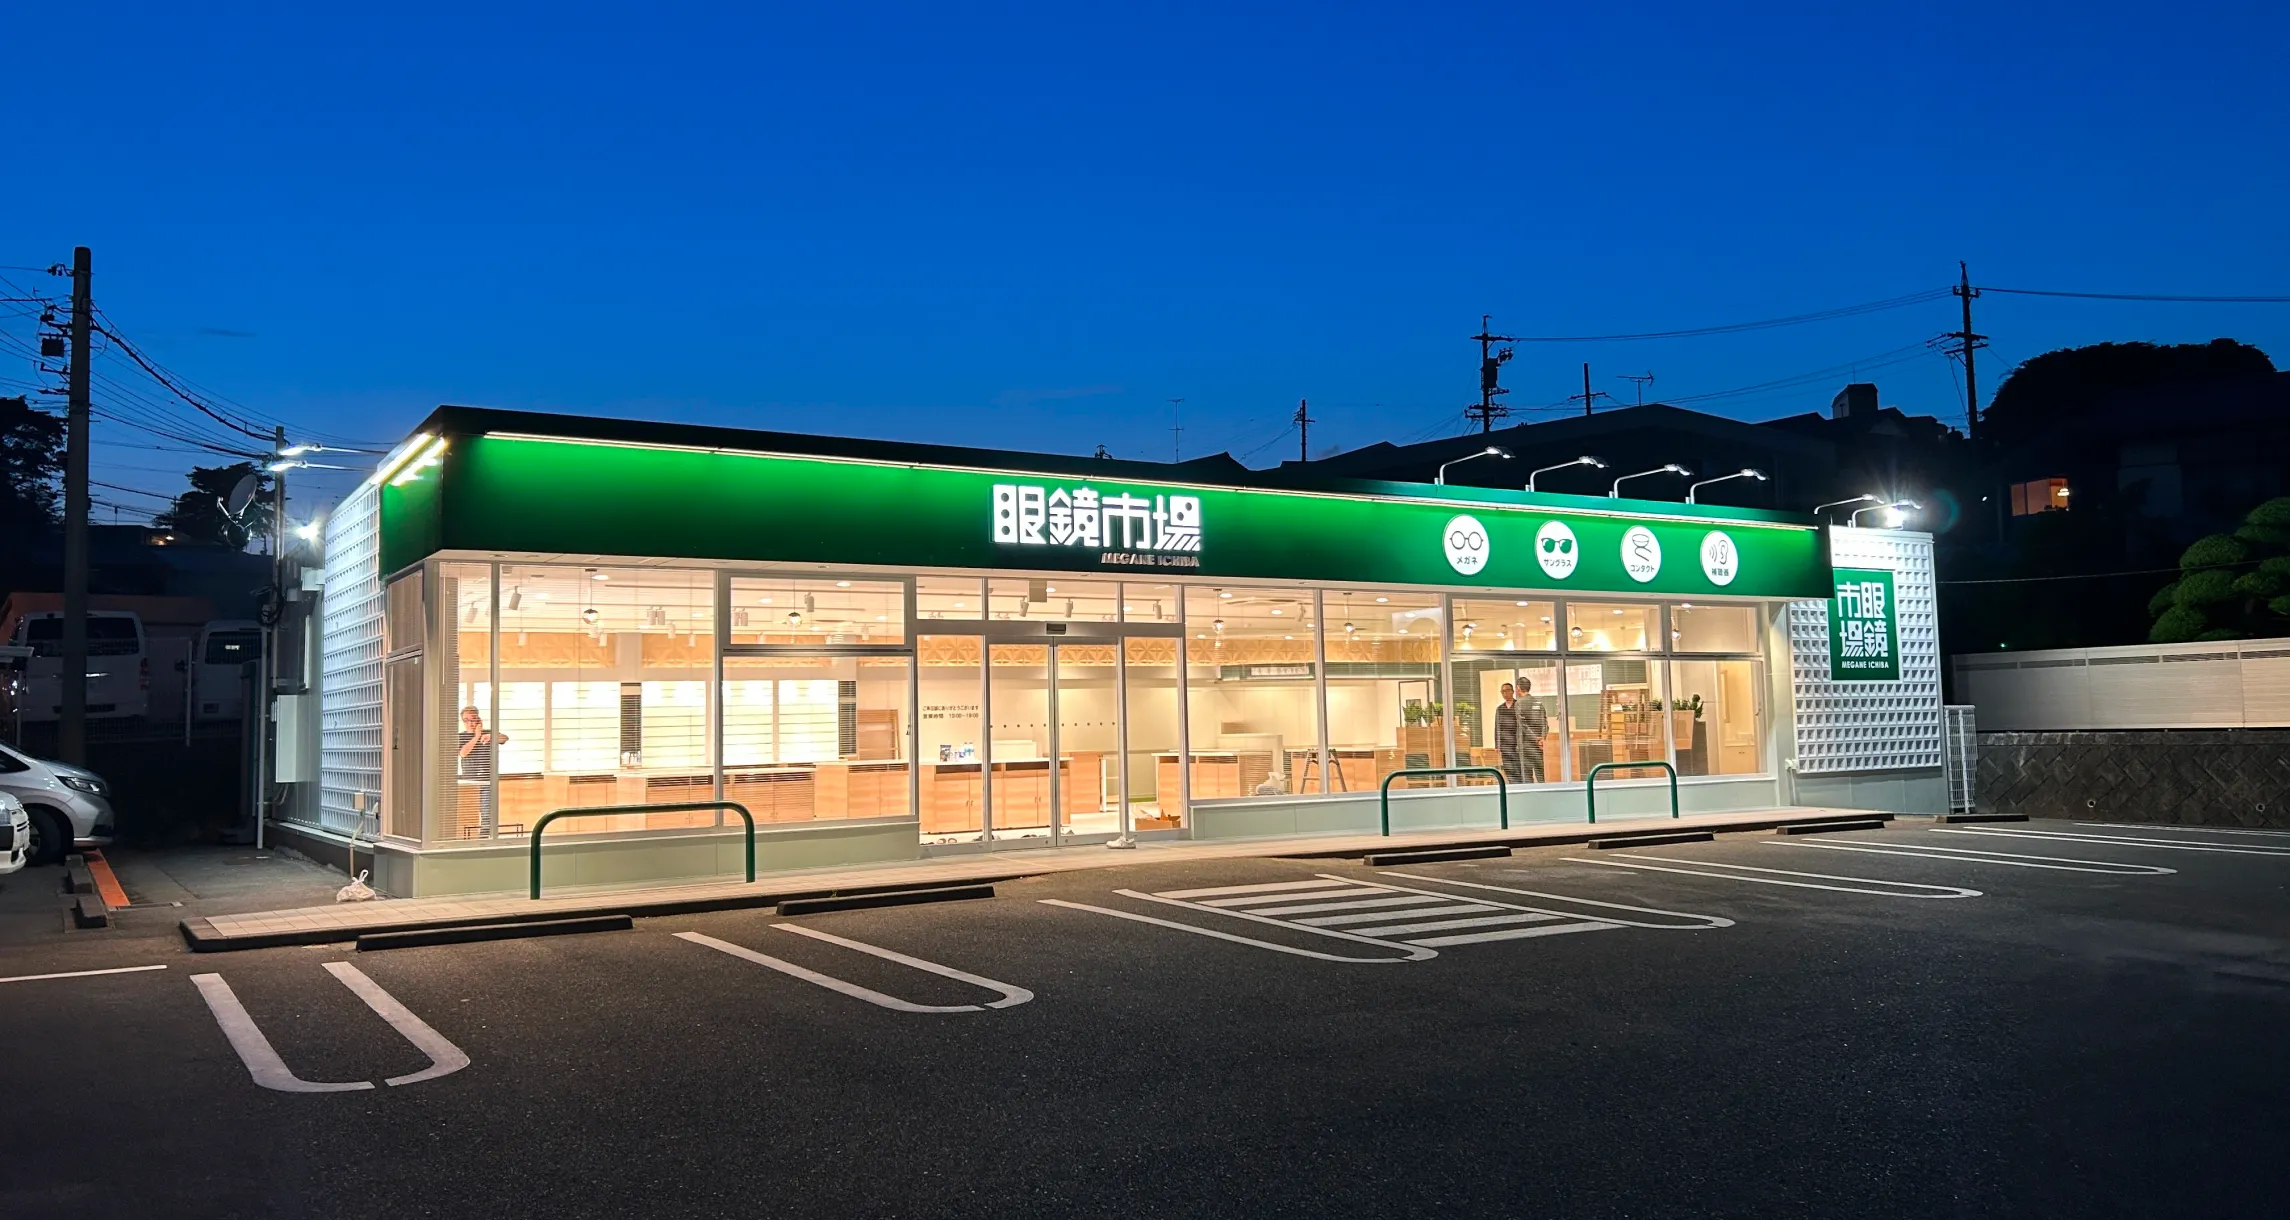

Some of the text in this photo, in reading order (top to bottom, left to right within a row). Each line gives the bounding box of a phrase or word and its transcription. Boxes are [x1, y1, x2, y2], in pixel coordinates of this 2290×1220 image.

[993, 485, 1200, 551] 眼鏡市場
[1101, 553, 1200, 567] MEGANE ICHIBA
[1456, 556, 1478, 565] メガネ
[1543, 558, 1572, 568] サングラス
[1630, 564, 1655, 573] コンタクト
[1841, 661, 1889, 669] MEGANE ICHIBA
